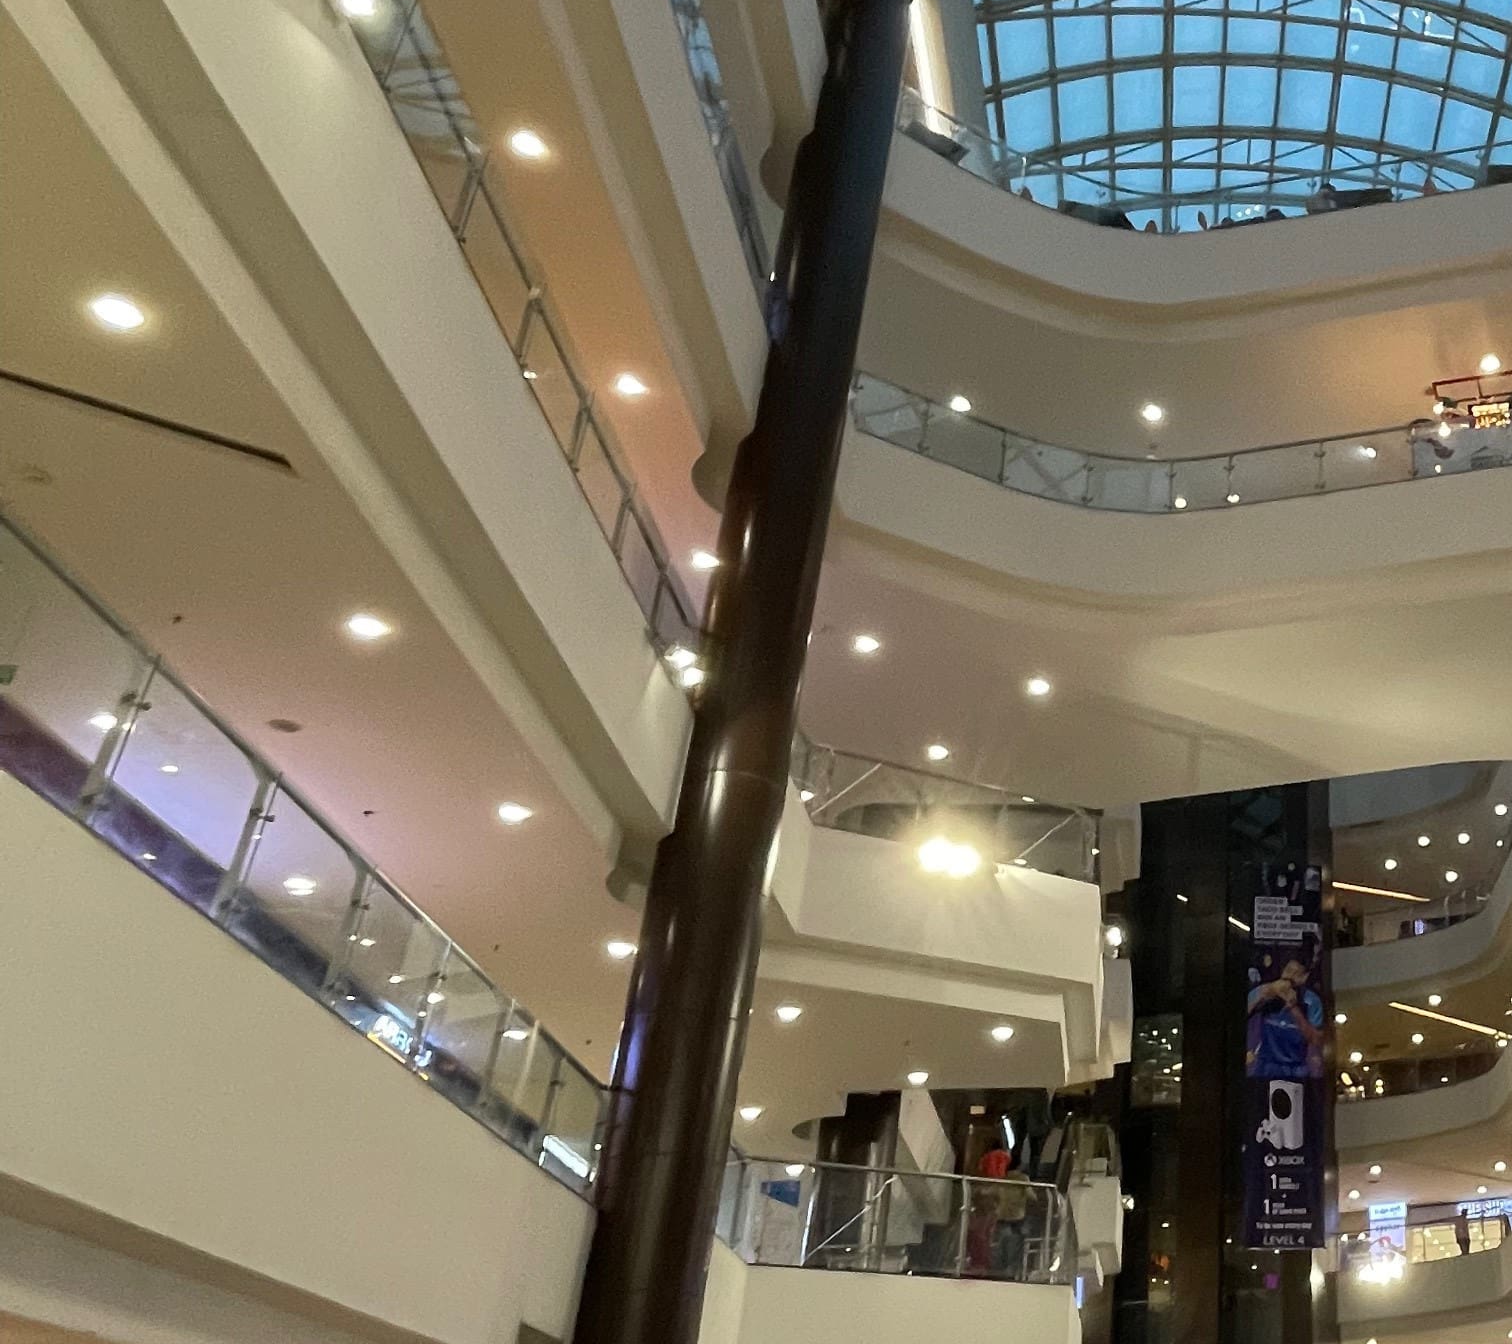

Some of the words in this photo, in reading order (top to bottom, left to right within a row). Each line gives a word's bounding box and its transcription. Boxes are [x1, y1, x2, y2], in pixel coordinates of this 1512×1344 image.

[1270, 1173, 1277, 1190] 1
[1263, 1199, 1270, 1214] 1
[1263, 1235, 1294, 1245] LEVEL
[1297, 1235, 1305, 1244] 4
